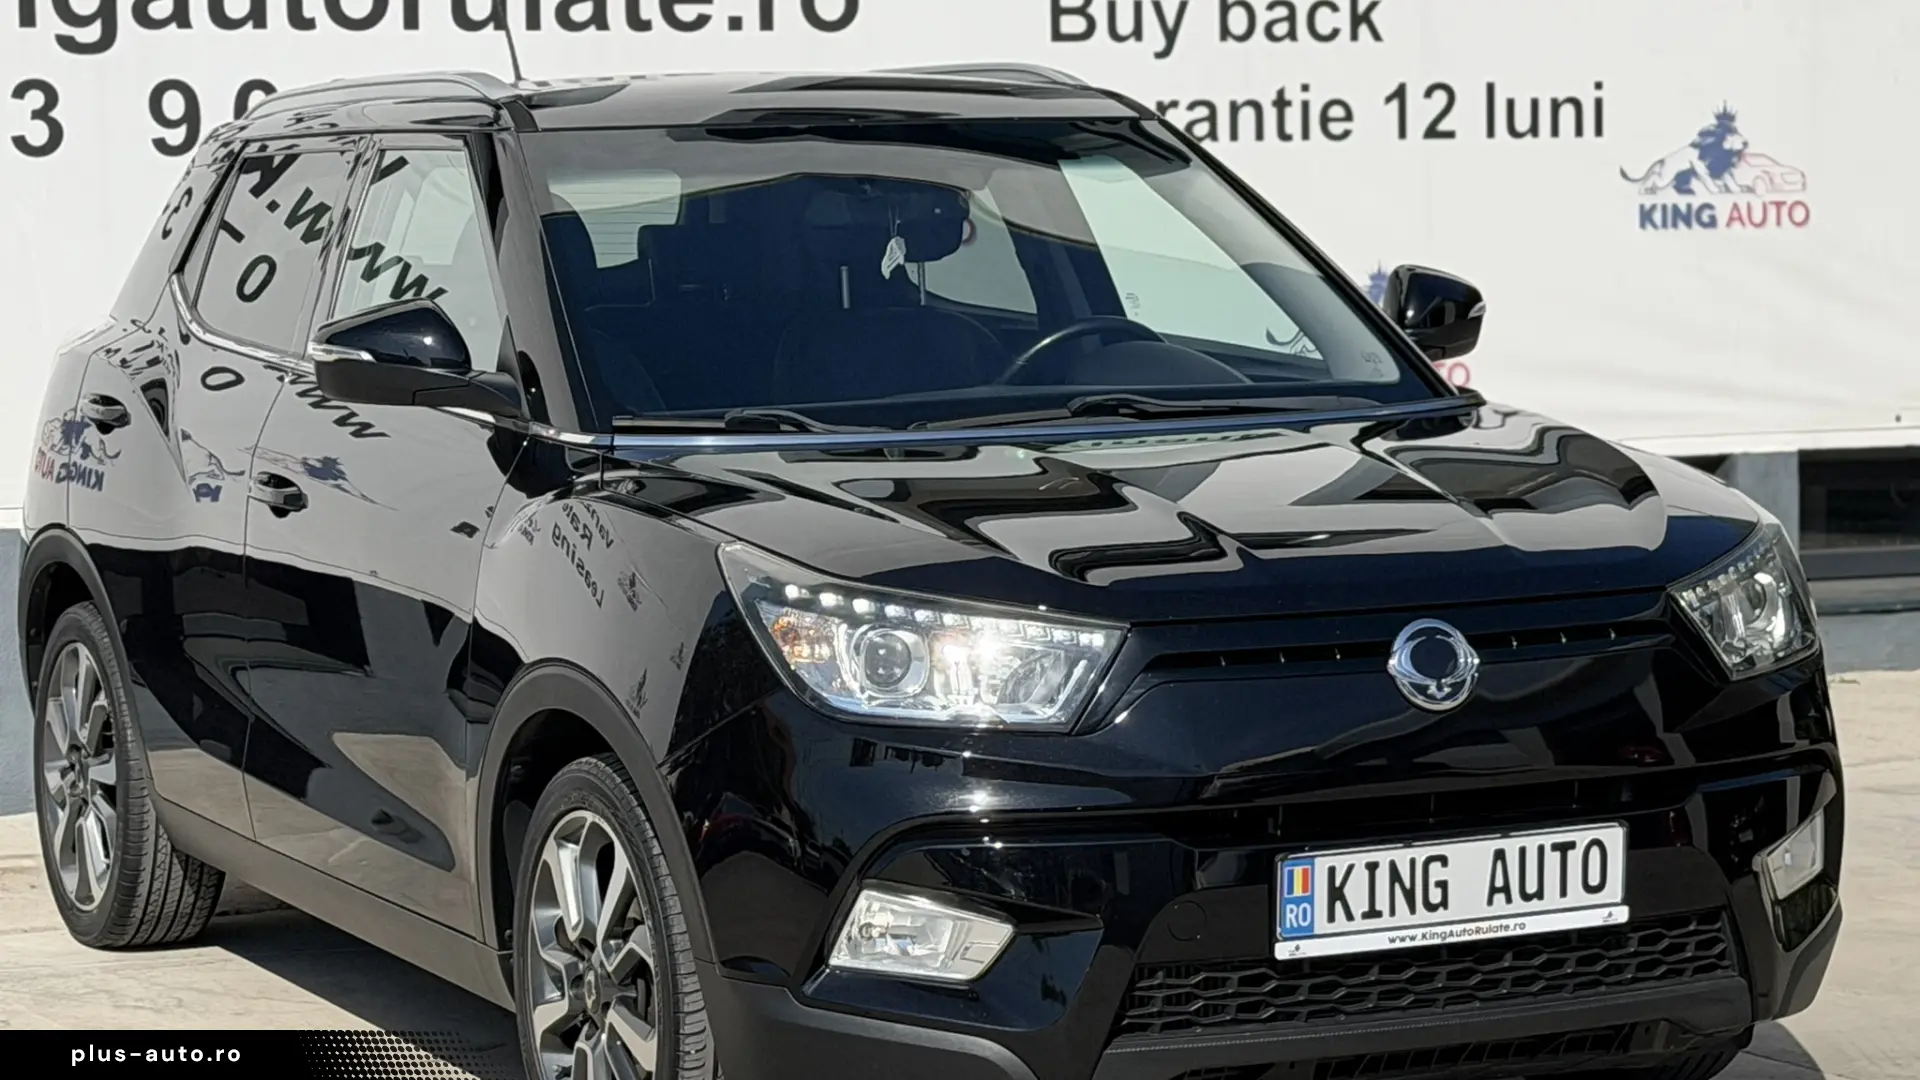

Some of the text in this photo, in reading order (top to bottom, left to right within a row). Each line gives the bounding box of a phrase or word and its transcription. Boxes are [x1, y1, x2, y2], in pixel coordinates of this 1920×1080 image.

[1049, 0, 1384, 59] Buy back
[11, 78, 64, 157] 3
[1384, 82, 1457, 140] 12
[1485, 81, 1605, 140] luni
[1638, 200, 1811, 231] KING AUTO
[1326, 837, 1608, 924] KING AUTO
[1286, 903, 1312, 928] RO
[1388, 922, 1527, 944] www.KingAutoRulate.ro
